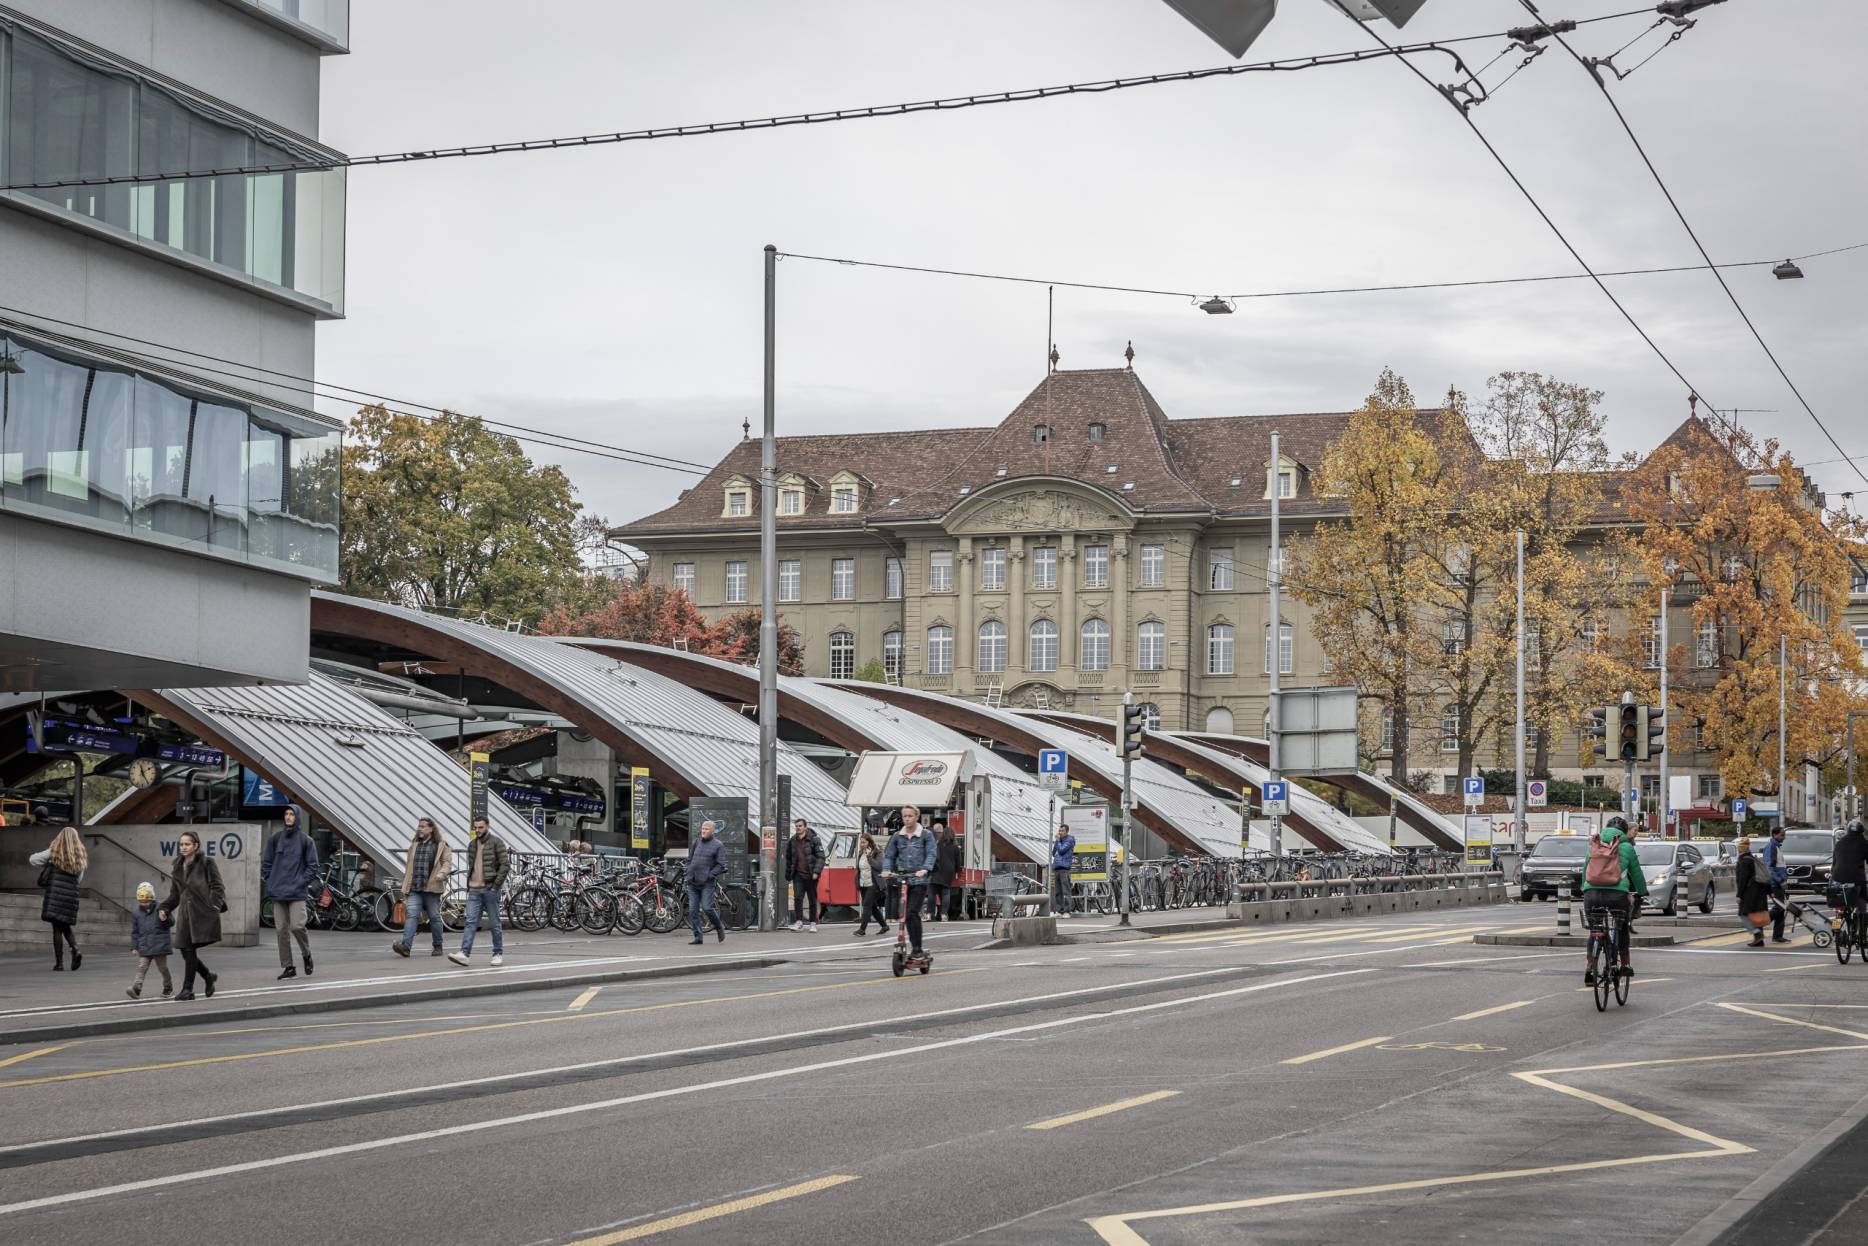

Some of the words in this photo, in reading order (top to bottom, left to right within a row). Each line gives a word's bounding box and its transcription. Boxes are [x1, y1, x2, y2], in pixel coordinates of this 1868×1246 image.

[1046, 753, 1061, 771] P
[1268, 784, 1281, 799] P
[1469, 780, 1479, 792] P
[1735, 802, 1743, 812] P
